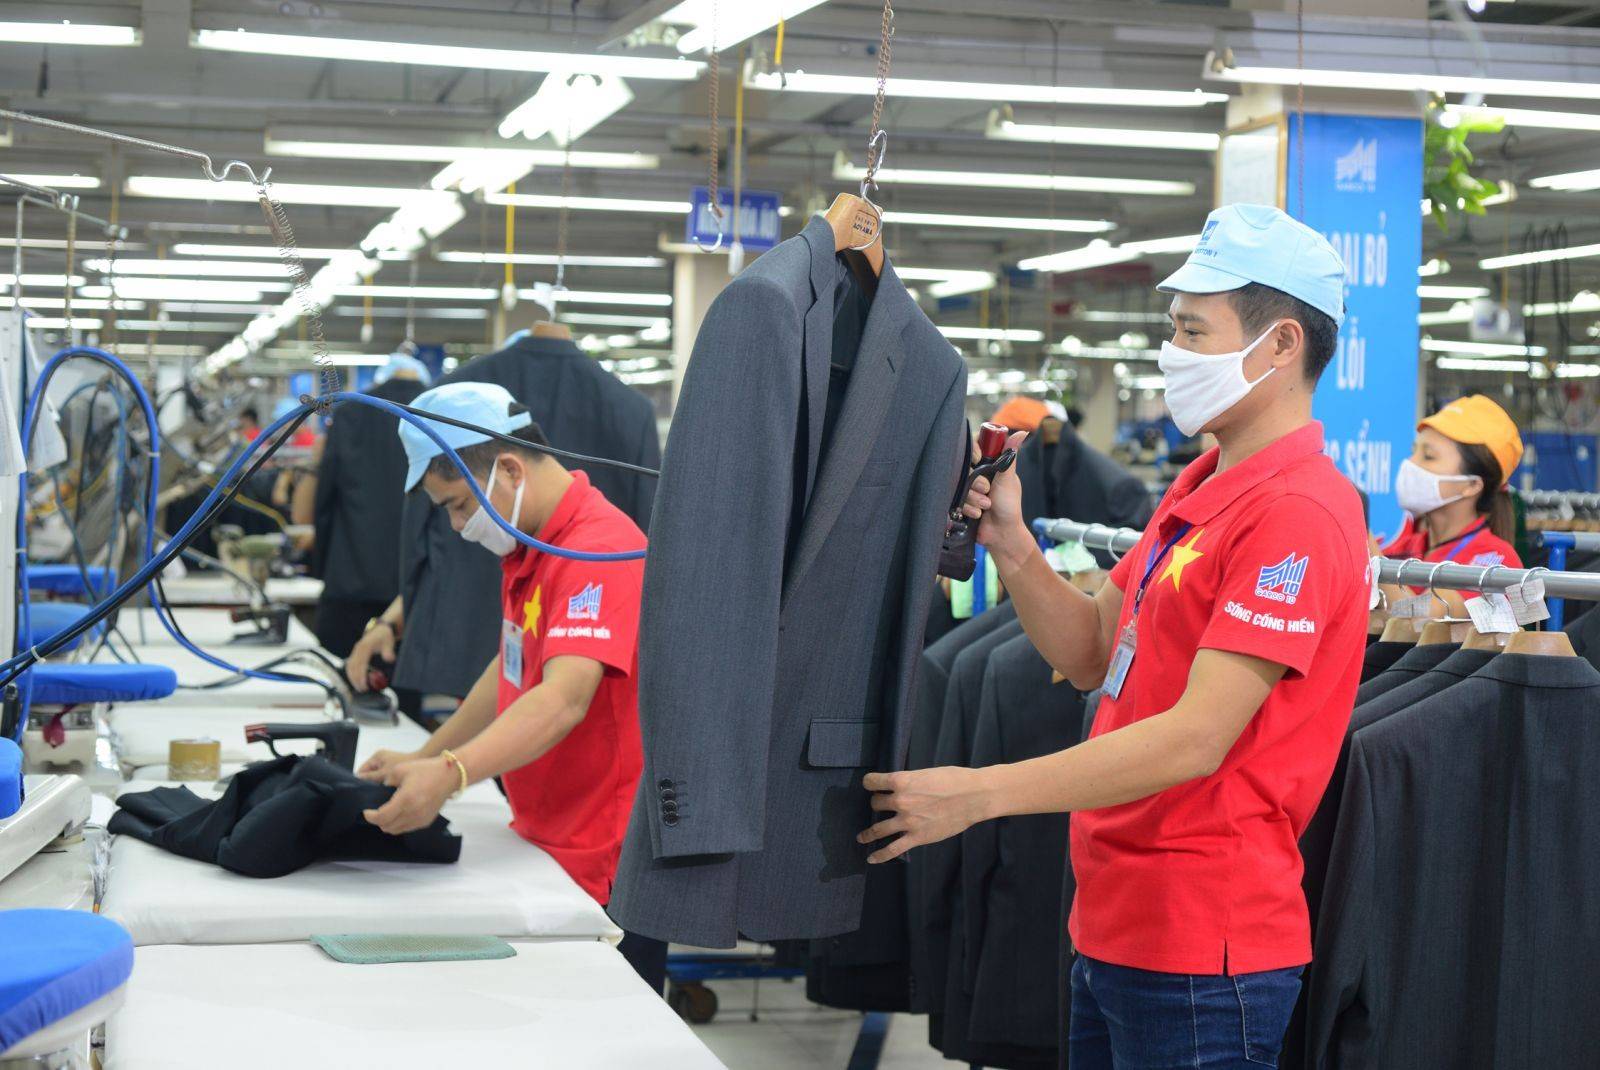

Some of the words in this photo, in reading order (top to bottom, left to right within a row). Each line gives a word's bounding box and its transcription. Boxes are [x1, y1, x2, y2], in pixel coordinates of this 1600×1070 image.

[1255, 588, 1285, 602] GARCO
[1224, 601, 1252, 623] SỐNG
[1252, 612, 1285, 631] CỐNG
[1287, 617, 1315, 633] HIẾN
